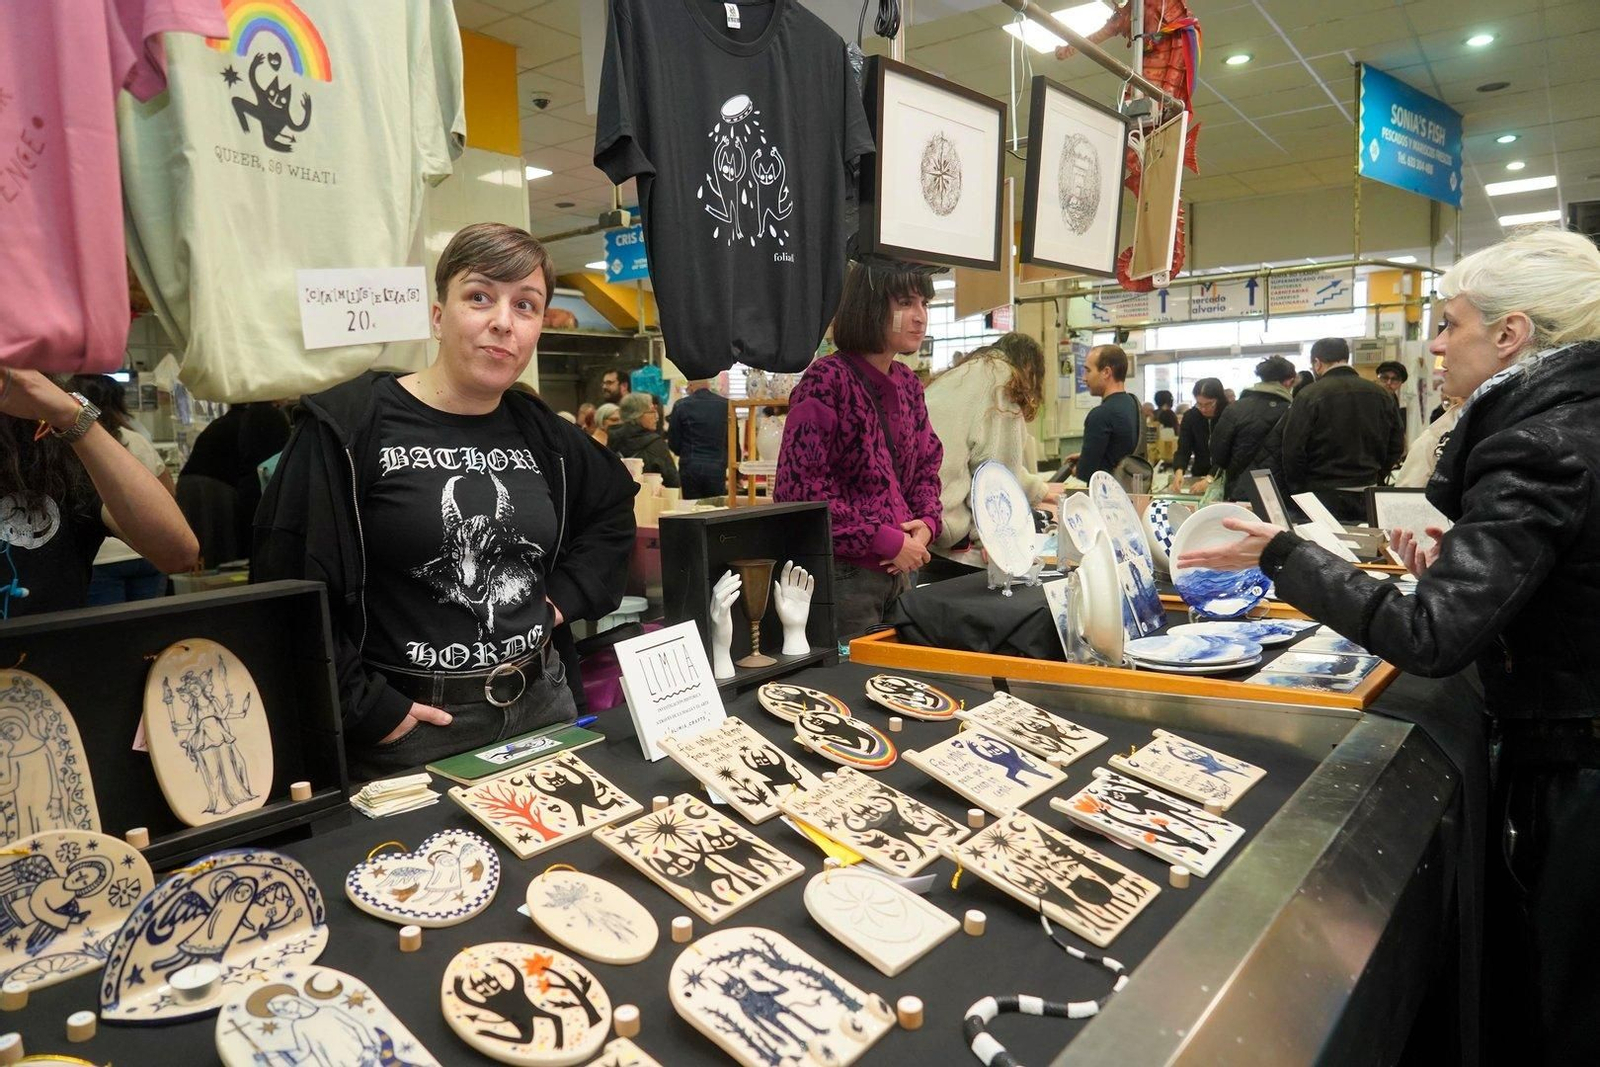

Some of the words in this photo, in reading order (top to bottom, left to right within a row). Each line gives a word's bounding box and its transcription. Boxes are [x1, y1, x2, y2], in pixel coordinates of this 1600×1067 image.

[1391, 103, 1427, 138] SONIA'S
[1427, 120, 1447, 147] FISH
[214, 145, 265, 172] QUEER,
[268, 159, 282, 175] SO
[616, 232, 638, 247] CRIS
[306, 287, 419, 305] CAMISETAS
[638, 643, 700, 696] LIMIA
